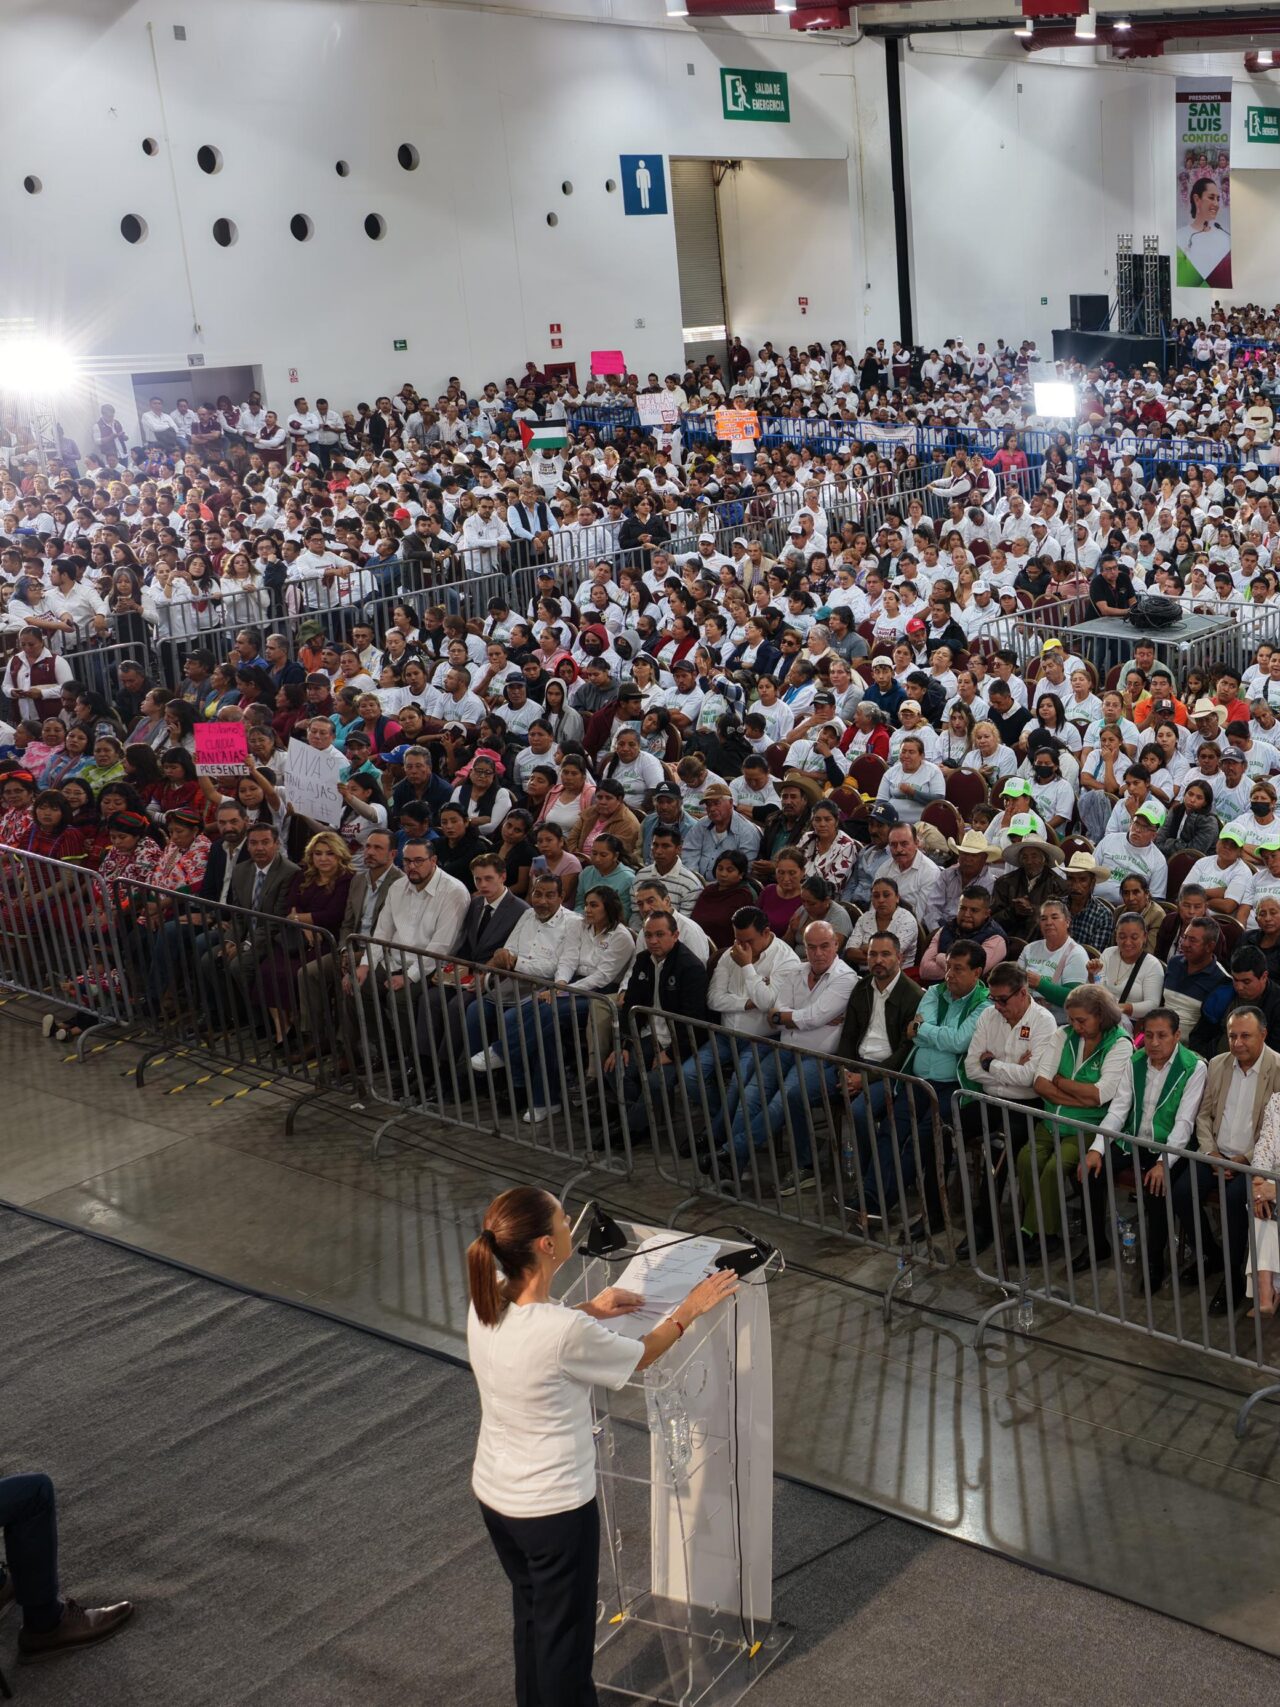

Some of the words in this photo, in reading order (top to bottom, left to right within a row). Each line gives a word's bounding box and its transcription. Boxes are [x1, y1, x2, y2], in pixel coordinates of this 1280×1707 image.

[755, 82, 773, 95] SALIDA
[773, 83, 781, 95] DE
[752, 99, 785, 111] EMERGENCIA
[1189, 103, 1220, 117] SAN
[1188, 118, 1222, 132] LUIS
[1182, 133, 1228, 143] CONTIGO
[290, 746, 321, 777] VIVA
[200, 764, 248, 775] PRESENTE
